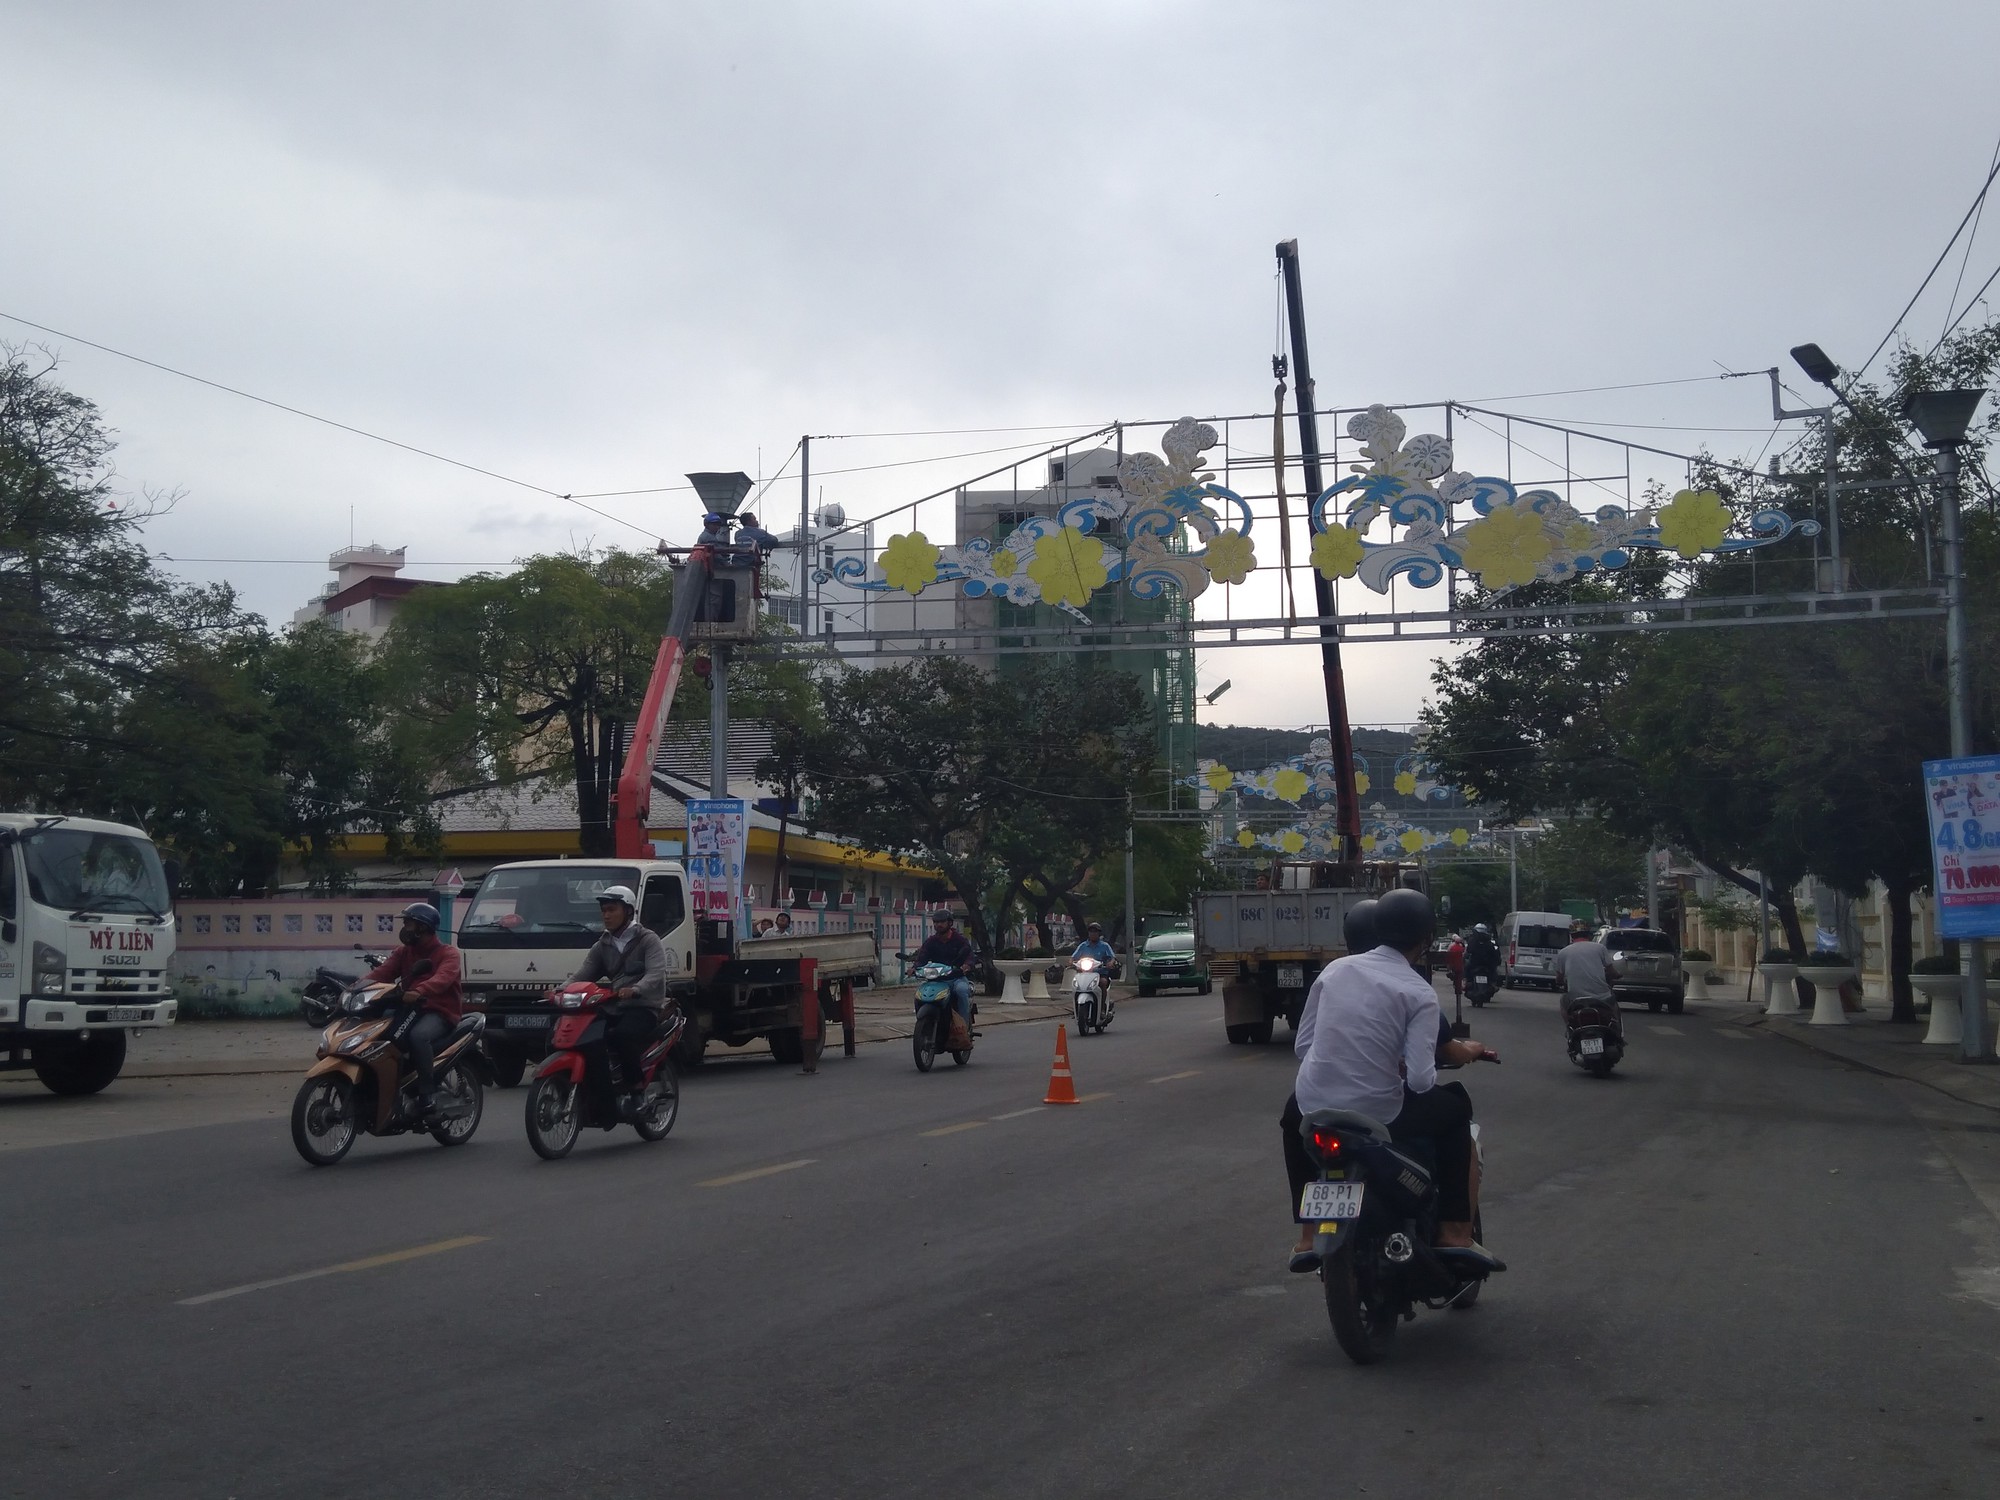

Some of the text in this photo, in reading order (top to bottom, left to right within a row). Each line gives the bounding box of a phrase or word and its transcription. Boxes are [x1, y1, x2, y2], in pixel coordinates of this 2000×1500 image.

[1947, 760, 1995, 772] vinaphone
[1977, 801, 1999, 812] DATA
[720, 838, 736, 847] DATA
[1240, 907, 1265, 921] 68C
[1314, 906, 1331, 920] 97
[119, 927, 154, 951] LIÊN
[102, 955, 141, 966] ISUZU
[1306, 1202, 1356, 1216] 157.86
